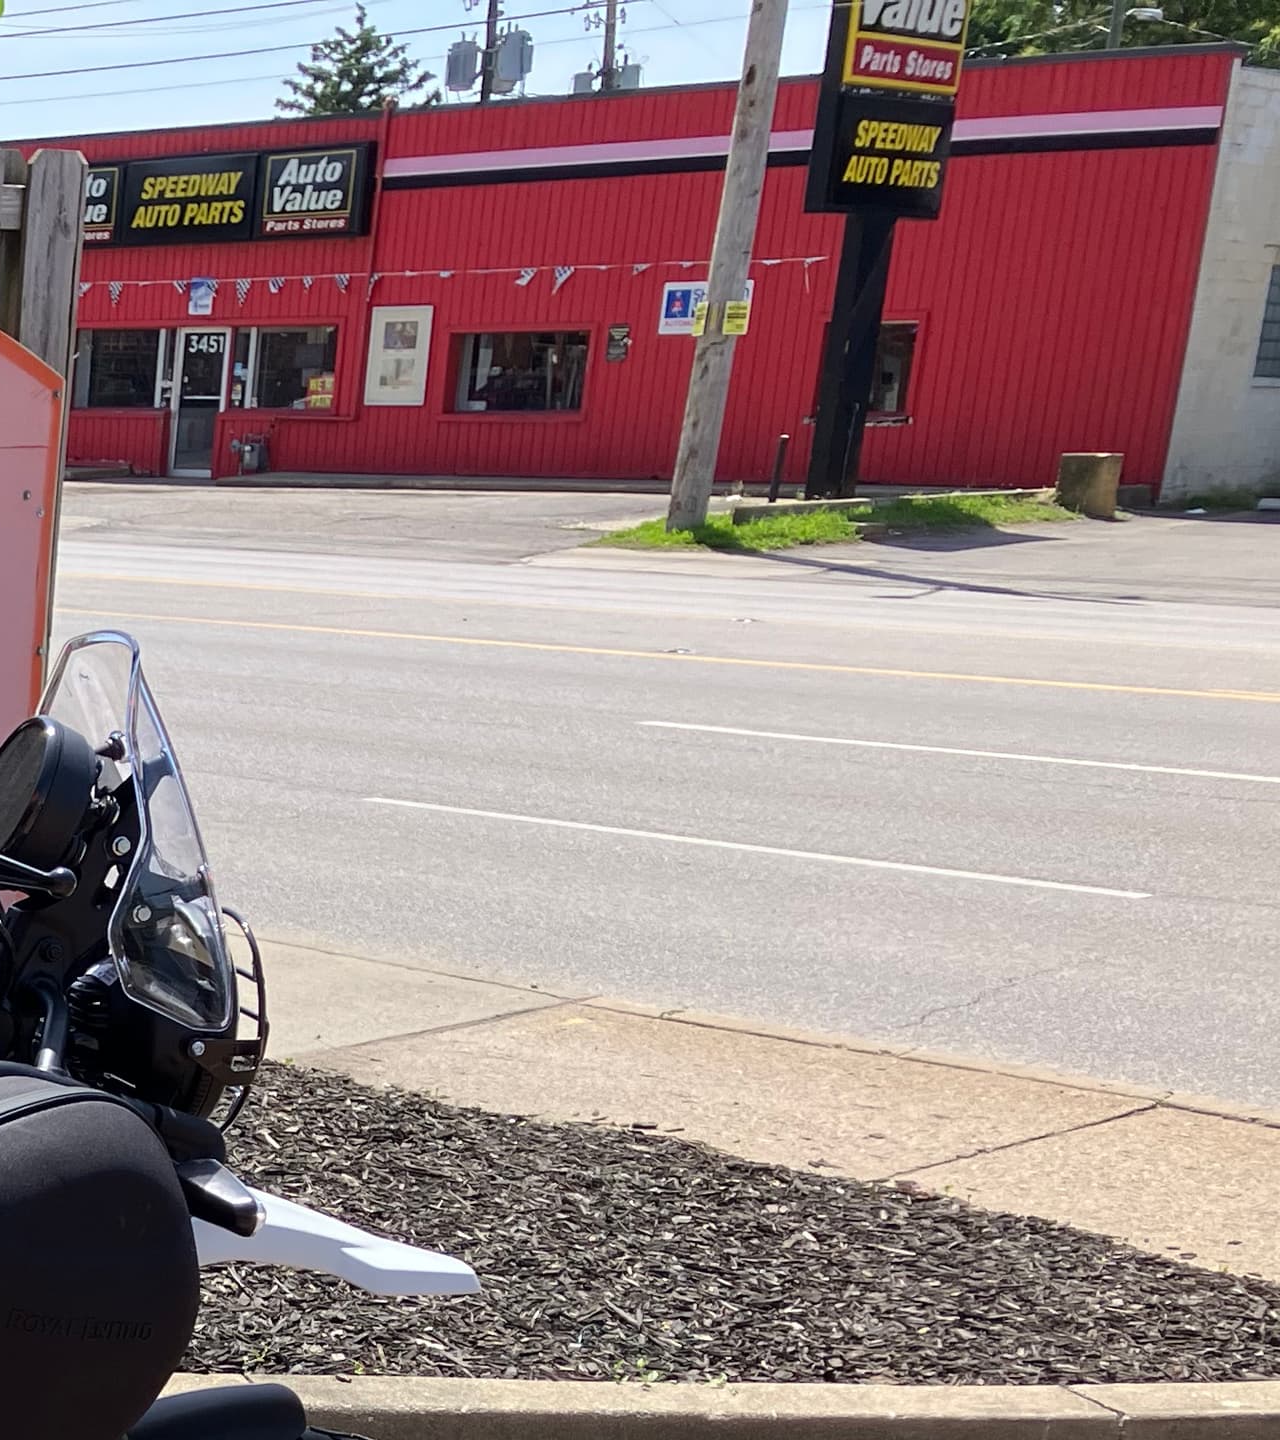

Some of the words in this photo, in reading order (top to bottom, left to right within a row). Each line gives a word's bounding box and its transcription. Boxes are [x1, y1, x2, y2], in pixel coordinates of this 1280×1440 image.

[862, 0, 966, 37] Value
[859, 45, 901, 73] Parts
[905, 51, 954, 80] Stores
[854, 119, 943, 153] SPEEDWAY
[85, 173, 108, 198] to
[140, 171, 243, 201] SPEEDWAY
[278, 156, 343, 186] Auto
[842, 155, 890, 184] AUTO
[889, 158, 940, 189] PARTS
[272, 184, 343, 213] Value
[131, 203, 181, 229] AUTO
[183, 200, 245, 226] PARTS
[265, 219, 300, 232] Parts
[302, 217, 345, 230] Stores
[189, 335, 225, 353] 3451
